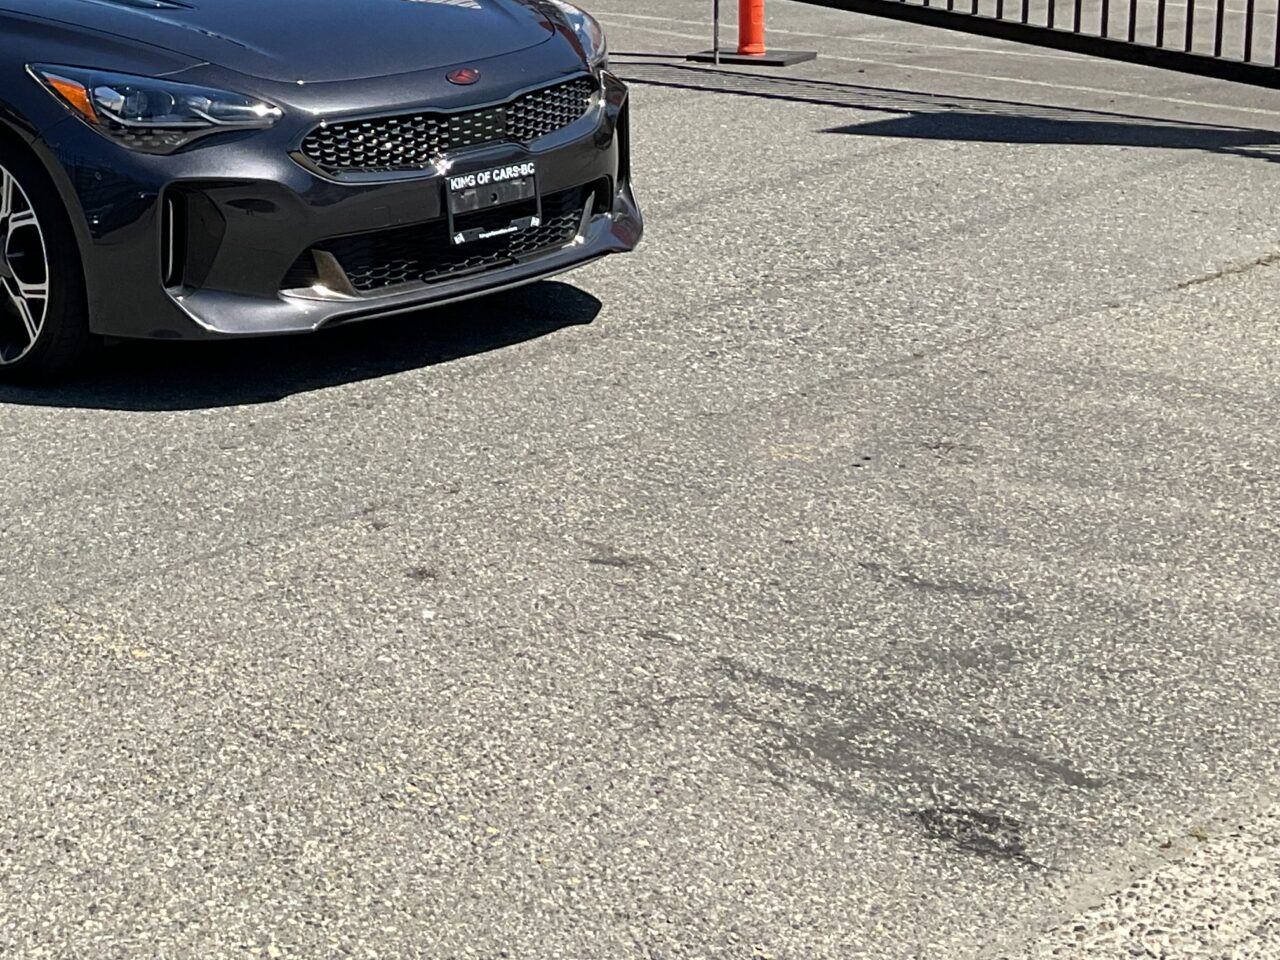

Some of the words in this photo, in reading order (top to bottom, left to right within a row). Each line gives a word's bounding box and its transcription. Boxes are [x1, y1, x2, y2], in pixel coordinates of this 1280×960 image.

[450, 174, 476, 191] KING
[476, 171, 491, 185] OF
[492, 165, 519, 182] CARS
